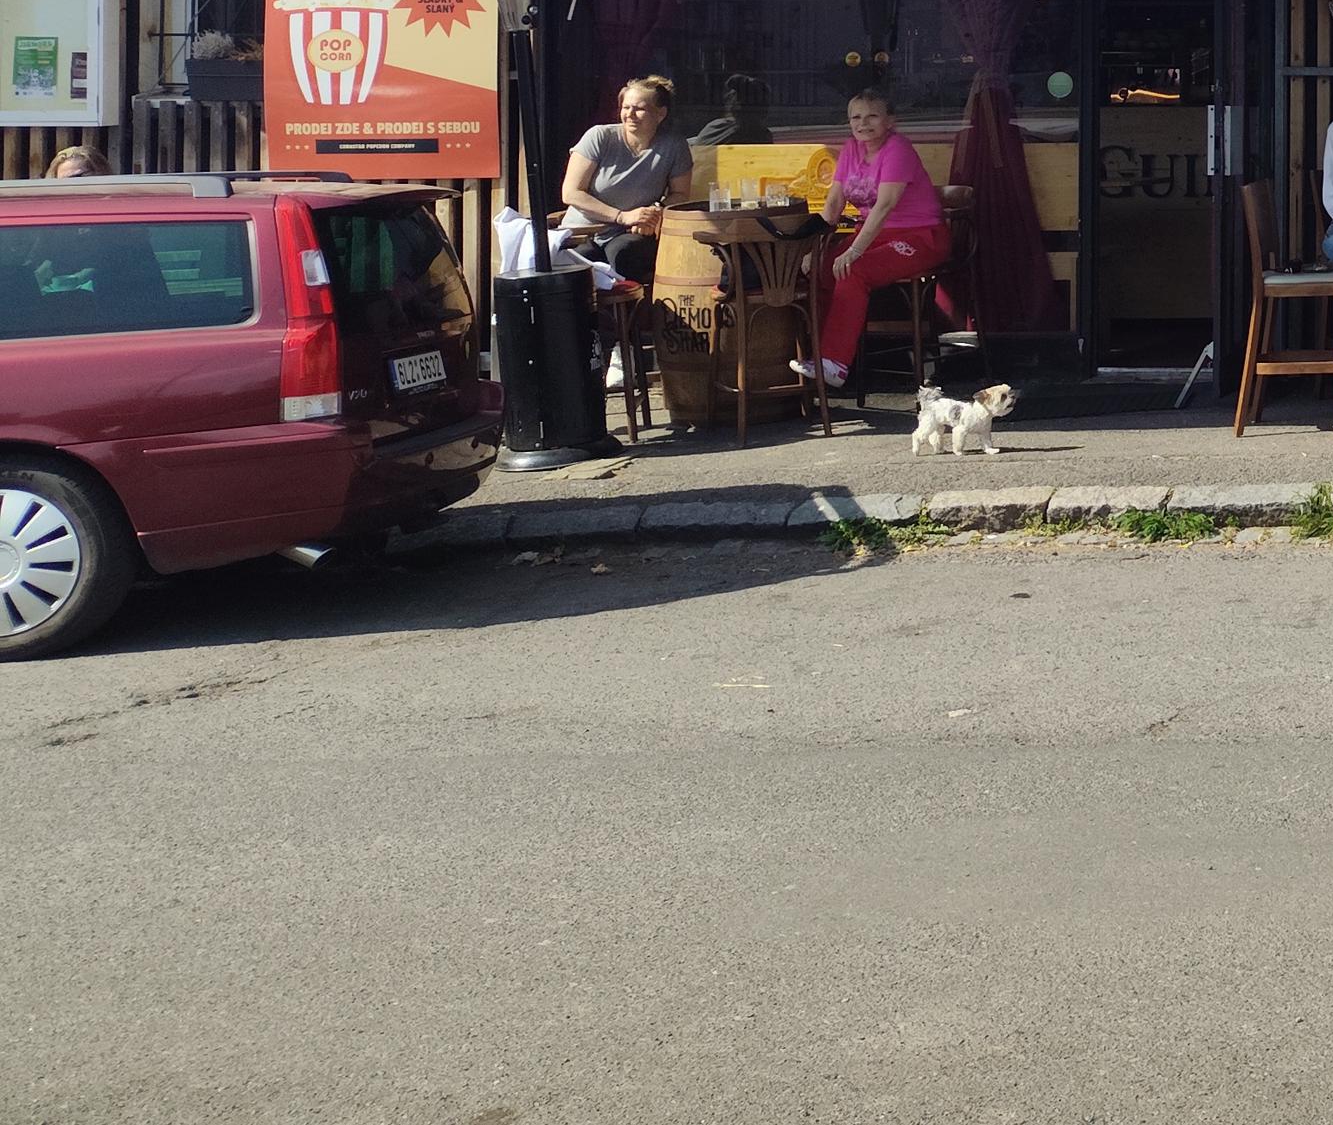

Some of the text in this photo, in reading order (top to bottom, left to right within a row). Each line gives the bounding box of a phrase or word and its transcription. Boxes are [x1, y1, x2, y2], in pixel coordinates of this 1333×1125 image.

[426, 3, 455, 13] SLANÝ
[320, 39, 351, 51] POP
[320, 52, 351, 61] CORN
[285, 121, 480, 135] PRODEJ ZDE & PRODEJ S SEBOU
[397, 354, 442, 385] 6L2 6632
